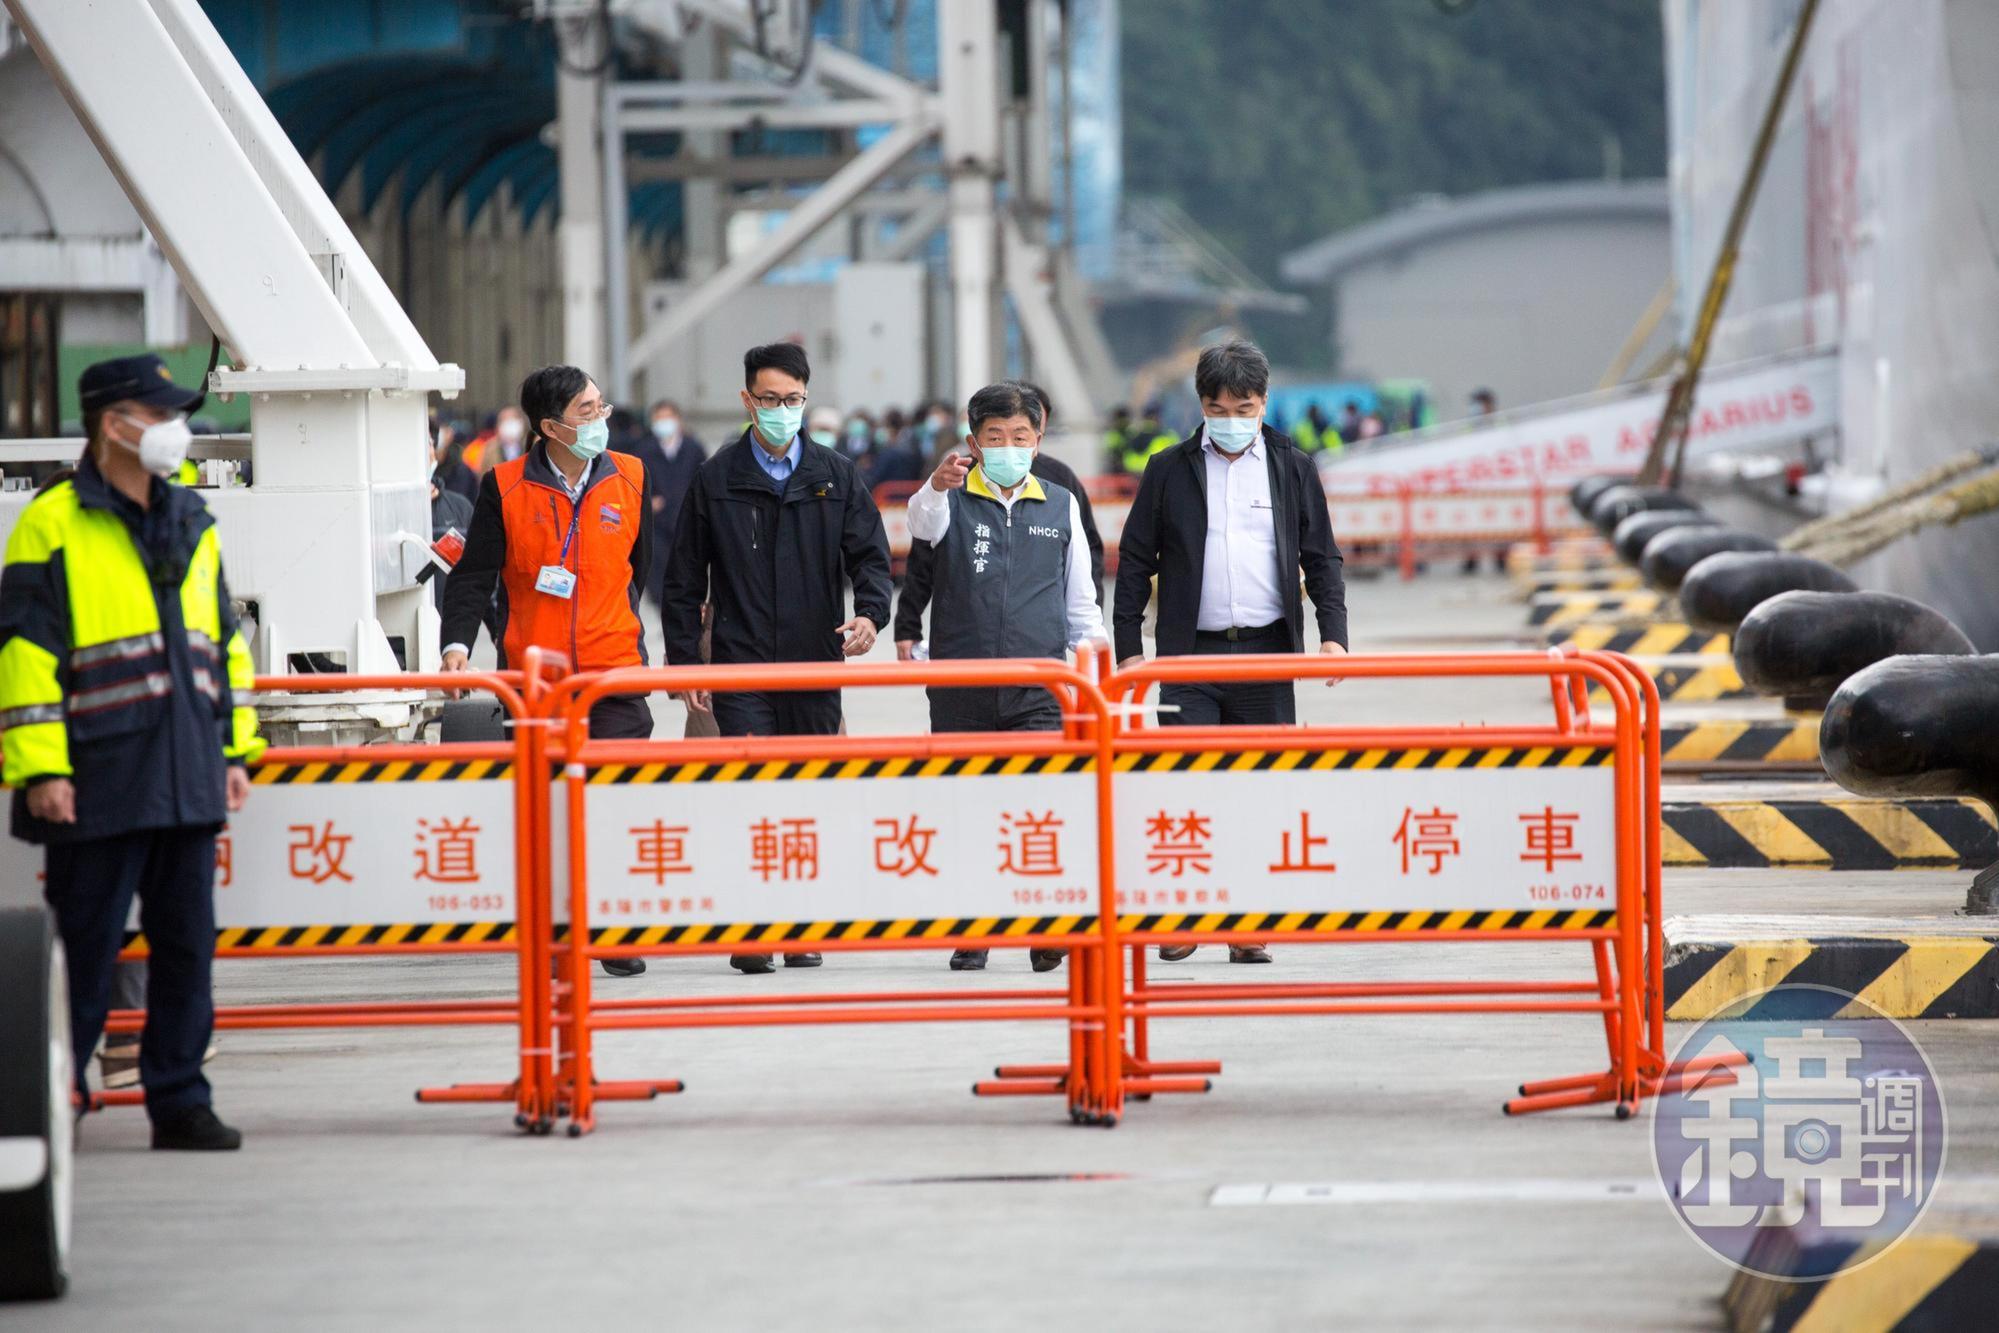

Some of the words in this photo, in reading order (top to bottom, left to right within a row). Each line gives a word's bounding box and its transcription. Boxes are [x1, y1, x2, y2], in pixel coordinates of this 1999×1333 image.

[973, 523, 990, 574] 指揮官
[1028, 525, 1060, 539] NHCC
[628, 809, 1065, 886] 車輛改道
[1145, 806, 1583, 877] 禁止停車
[1012, 887, 1089, 904] 106-099
[1528, 883, 1606, 901] 106-074
